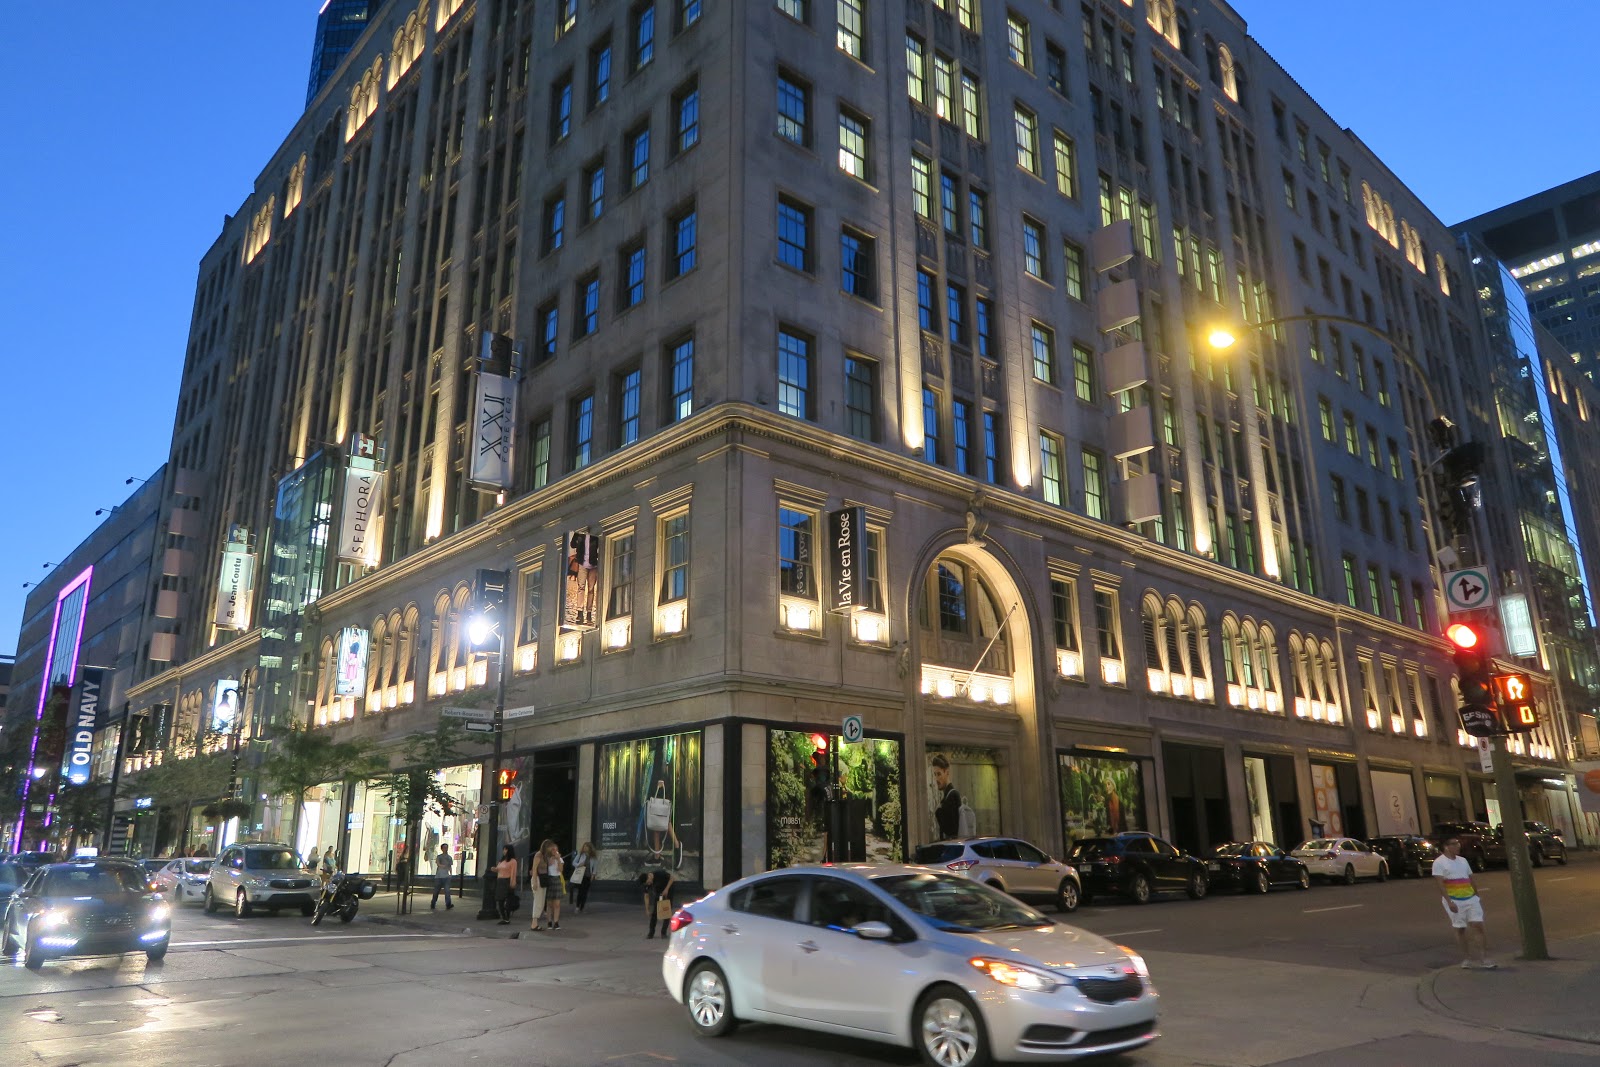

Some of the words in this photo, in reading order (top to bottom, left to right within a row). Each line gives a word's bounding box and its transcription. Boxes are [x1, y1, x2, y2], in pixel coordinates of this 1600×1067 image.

[502, 397, 512, 462] FOREVER
[351, 475, 371, 554] SEPHORA
[838, 512, 851, 549] Rose
[78, 680, 100, 728] NAVY
[72, 730, 93, 766] OLD
